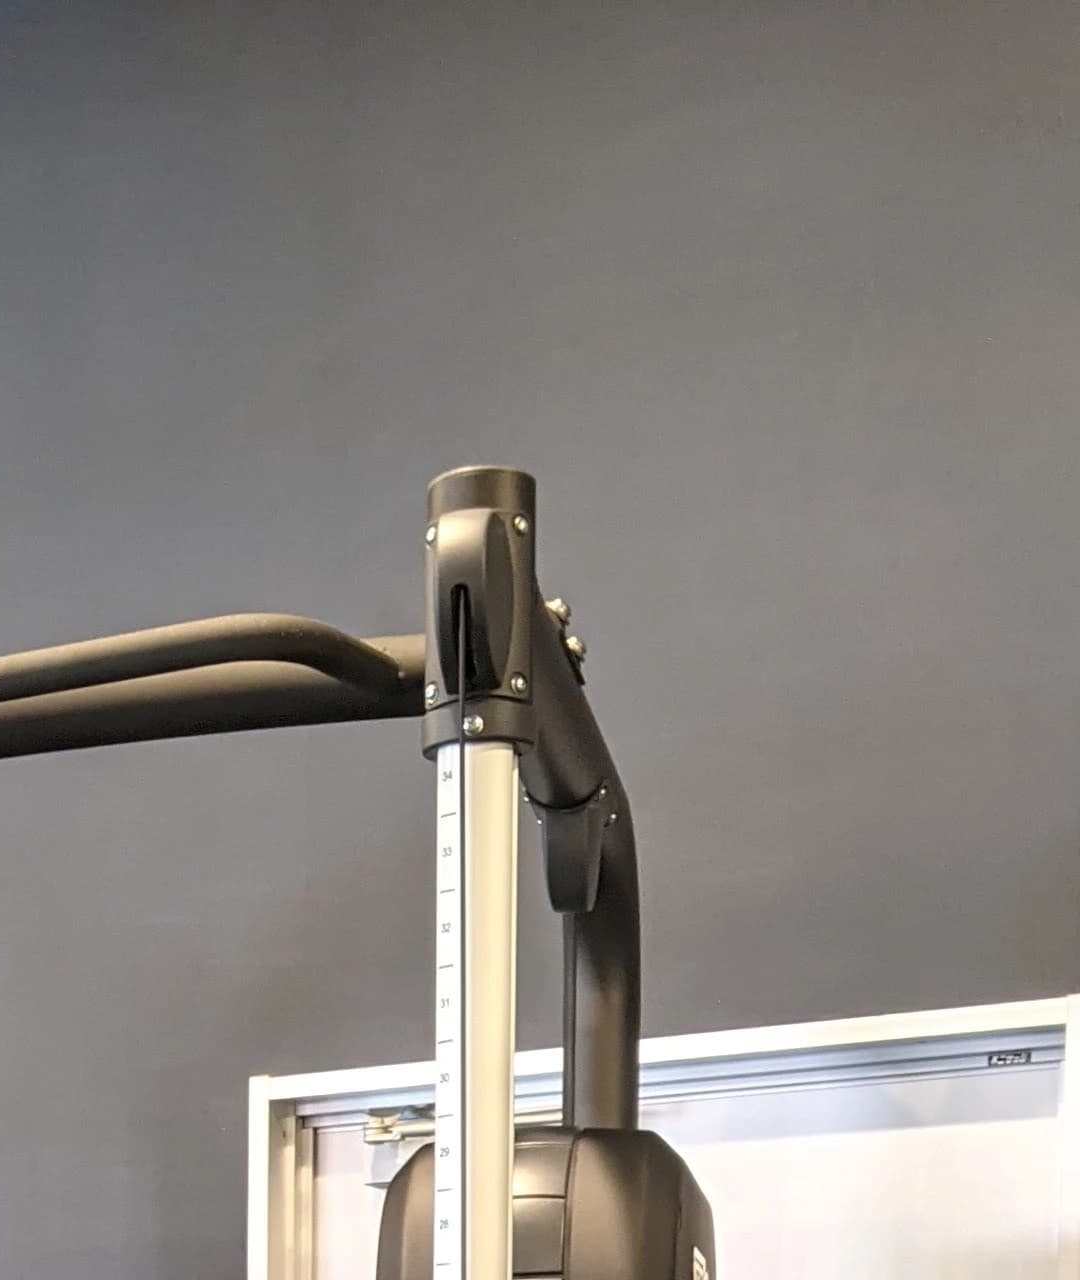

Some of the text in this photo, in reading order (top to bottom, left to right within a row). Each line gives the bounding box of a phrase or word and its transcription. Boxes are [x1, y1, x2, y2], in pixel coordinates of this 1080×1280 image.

[442, 770, 452, 782] 34
[442, 846, 452, 858] 33
[441, 922, 451, 933] 32
[440, 998, 449, 1008] 31
[440, 1073, 449, 1083] 30
[440, 1147, 449, 1157] 29
[440, 1219, 448, 1230] 28
